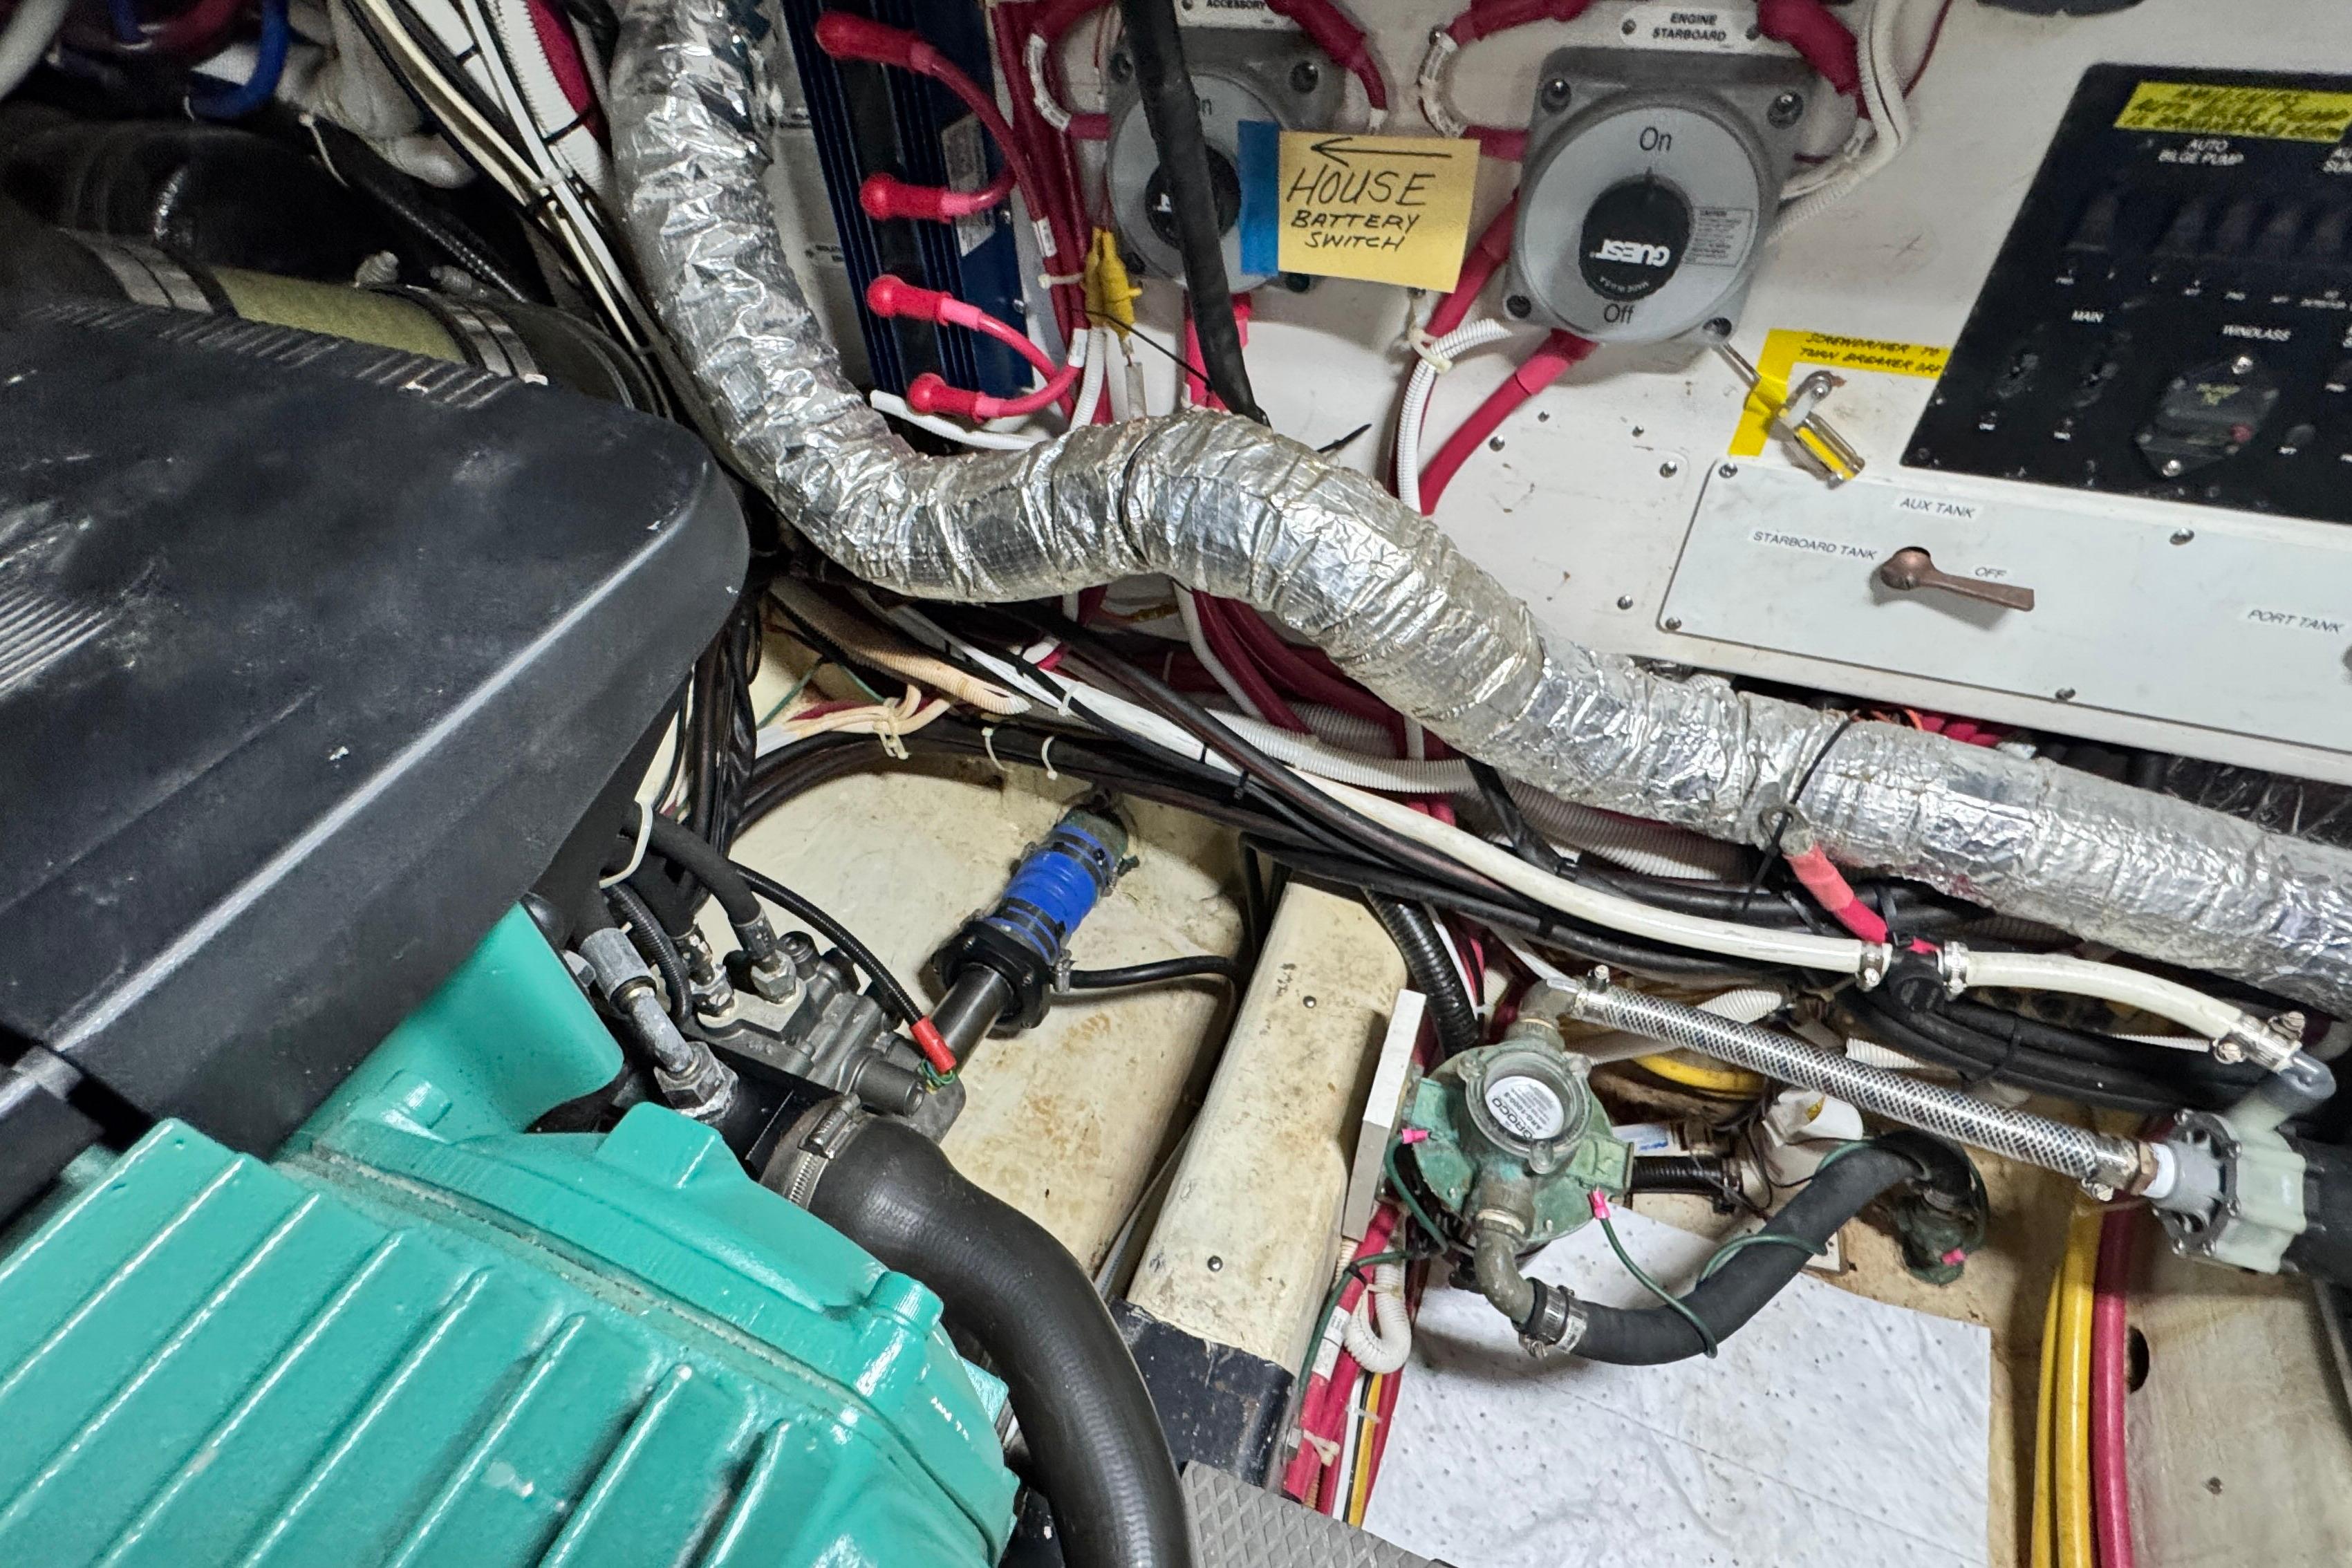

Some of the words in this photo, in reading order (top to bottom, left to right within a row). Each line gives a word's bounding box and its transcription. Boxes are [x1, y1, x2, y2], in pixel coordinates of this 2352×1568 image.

[1670, 12, 1717, 26] ENGINE
[1652, 27, 1727, 41] STARBOARD
[1639, 127, 1672, 151] On
[2187, 138, 2228, 152] AUTO
[2201, 151, 2245, 166] PUMP
[1286, 164, 1435, 206] HOUSE
[1291, 209, 1420, 234] BATTERY
[1304, 232, 1405, 252] SWITCH
[1595, 239, 1671, 268] GUEST
[1603, 304, 1634, 324] Off
[2071, 310, 2104, 323] MAIN
[2222, 324, 2291, 342] WINDLASS
[1899, 497, 1931, 512] AUX
[1935, 502, 1977, 519] TANK
[1753, 531, 1836, 553] STARBOARD
[1840, 545, 1878, 560] TANK
[1974, 567, 2007, 578] OFF
[2248, 609, 2297, 624] PORT
[2299, 616, 2346, 635] TANK
